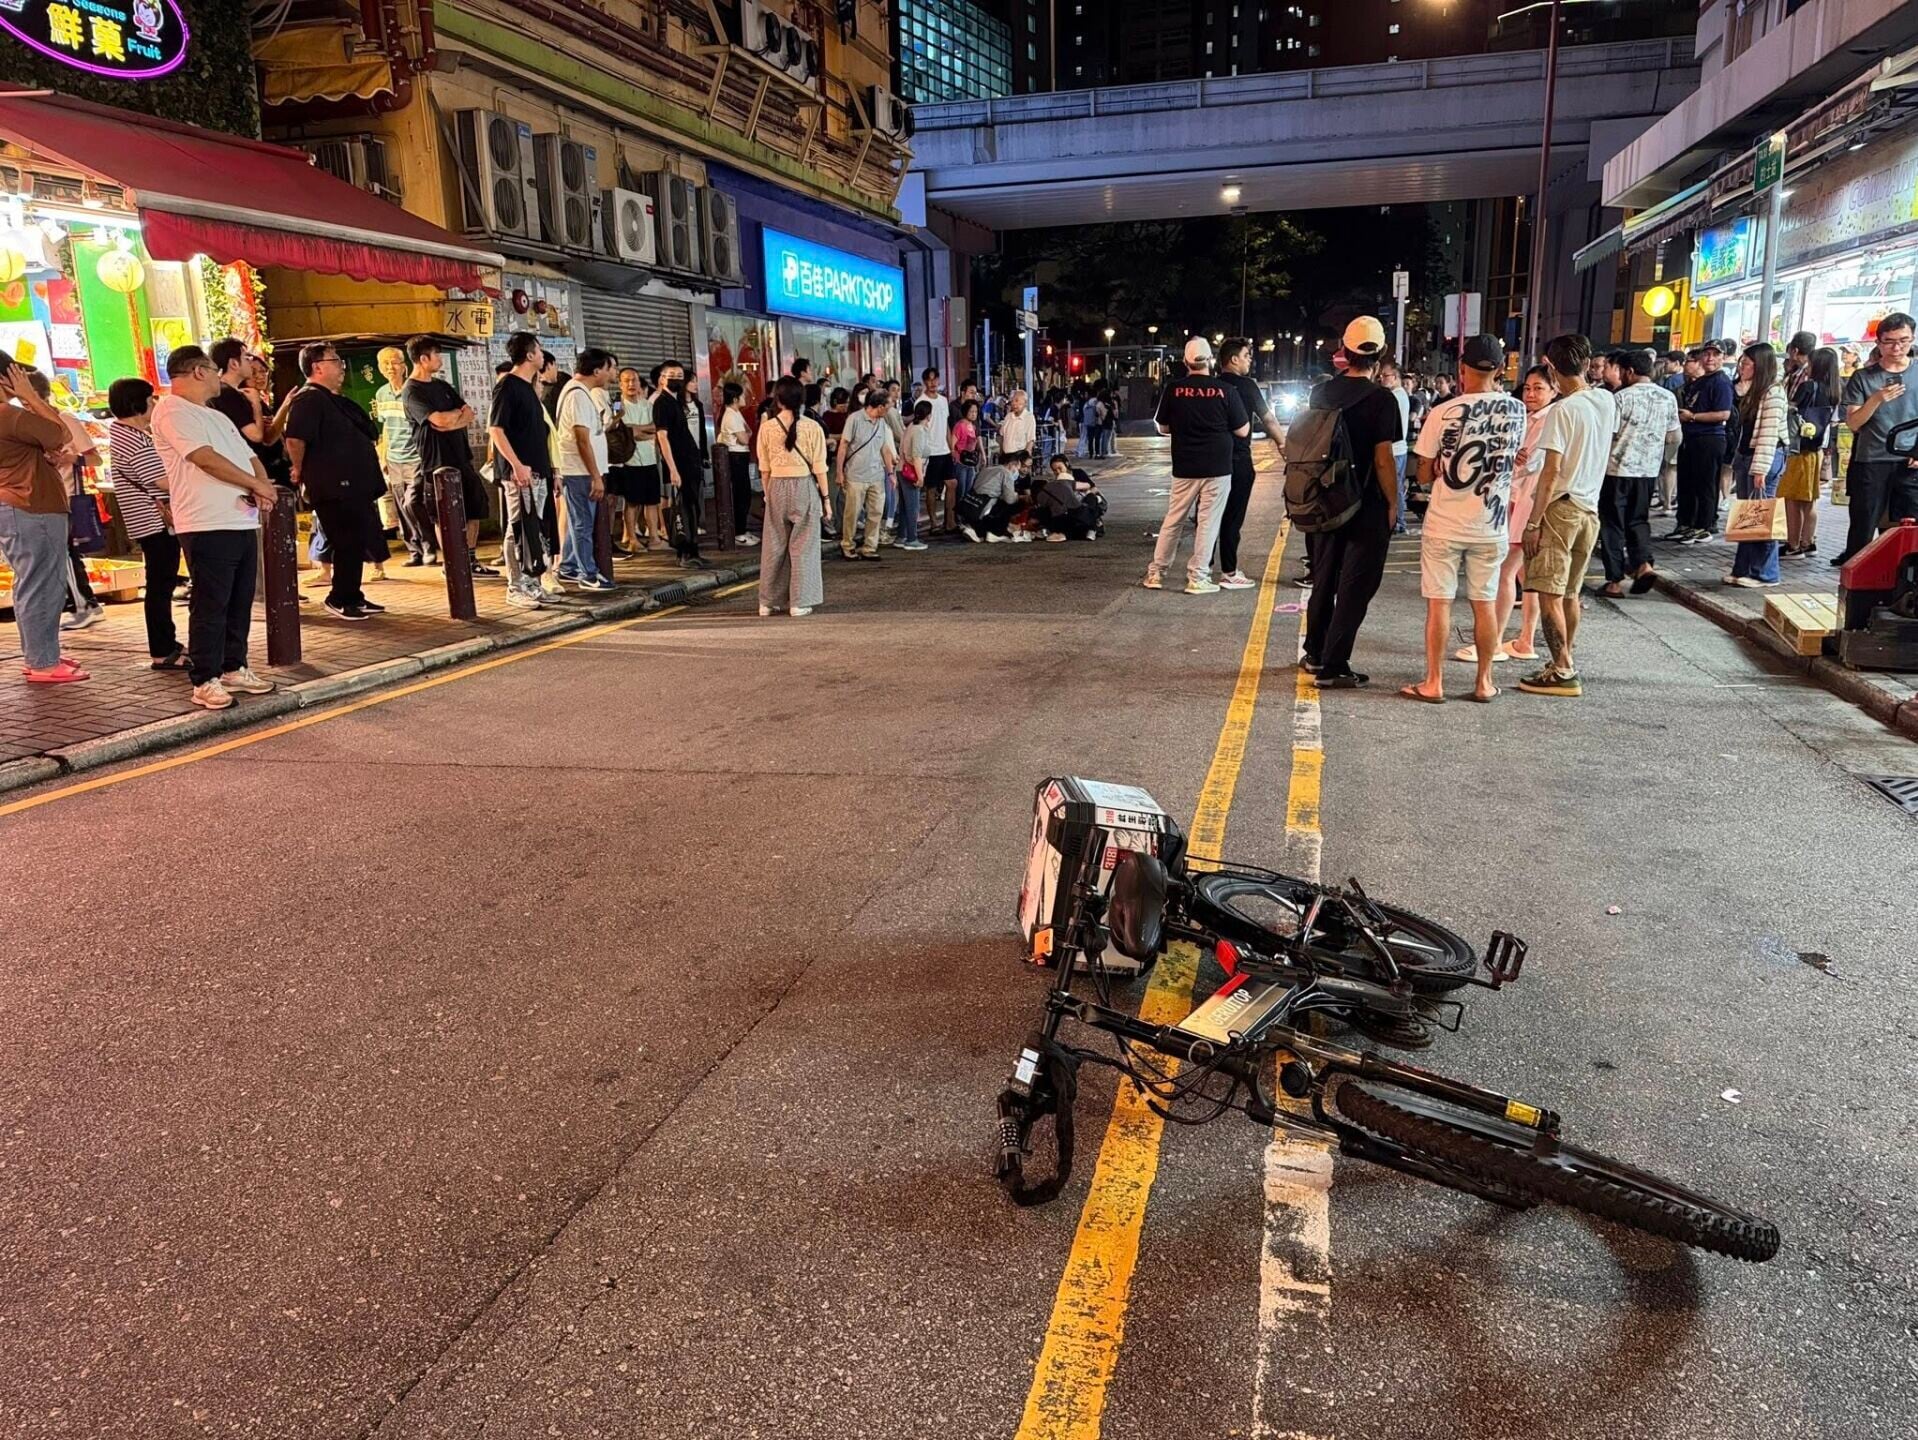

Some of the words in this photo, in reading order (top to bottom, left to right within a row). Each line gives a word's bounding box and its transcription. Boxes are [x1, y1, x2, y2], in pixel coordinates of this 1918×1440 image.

[127, 38, 162, 60] Fruit
[800, 261, 825, 298] 百佳
[447, 307, 492, 335] 水電
[1175, 387, 1225, 398] PRADA
